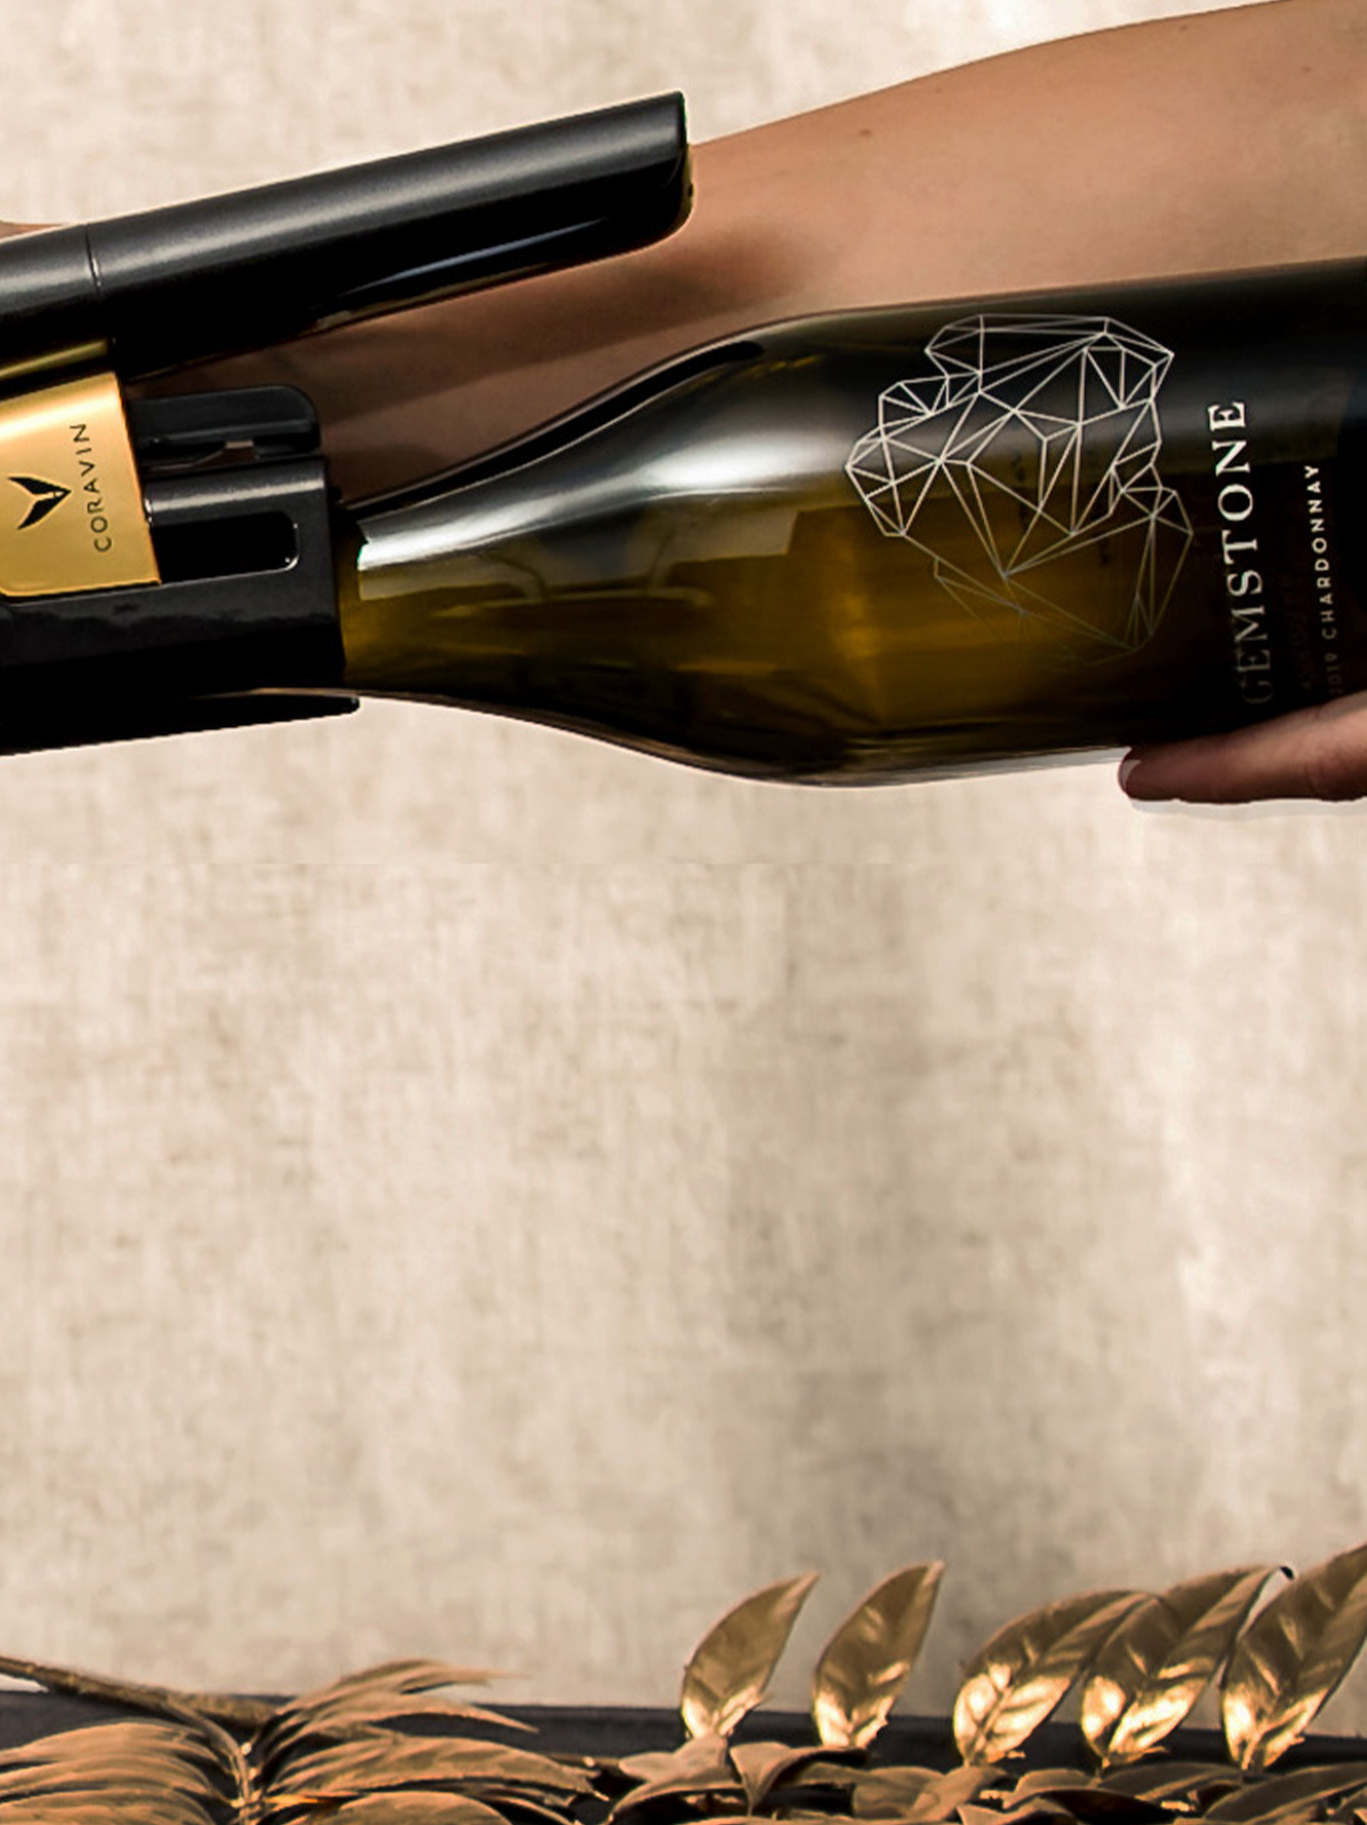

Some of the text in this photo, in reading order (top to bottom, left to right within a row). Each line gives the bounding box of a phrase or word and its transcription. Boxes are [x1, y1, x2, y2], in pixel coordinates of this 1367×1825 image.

[69, 424, 112, 552] CORAVIN
[1208, 402, 1274, 704] GEMSTONE
[1305, 465, 1337, 639] CHARDONNAY
